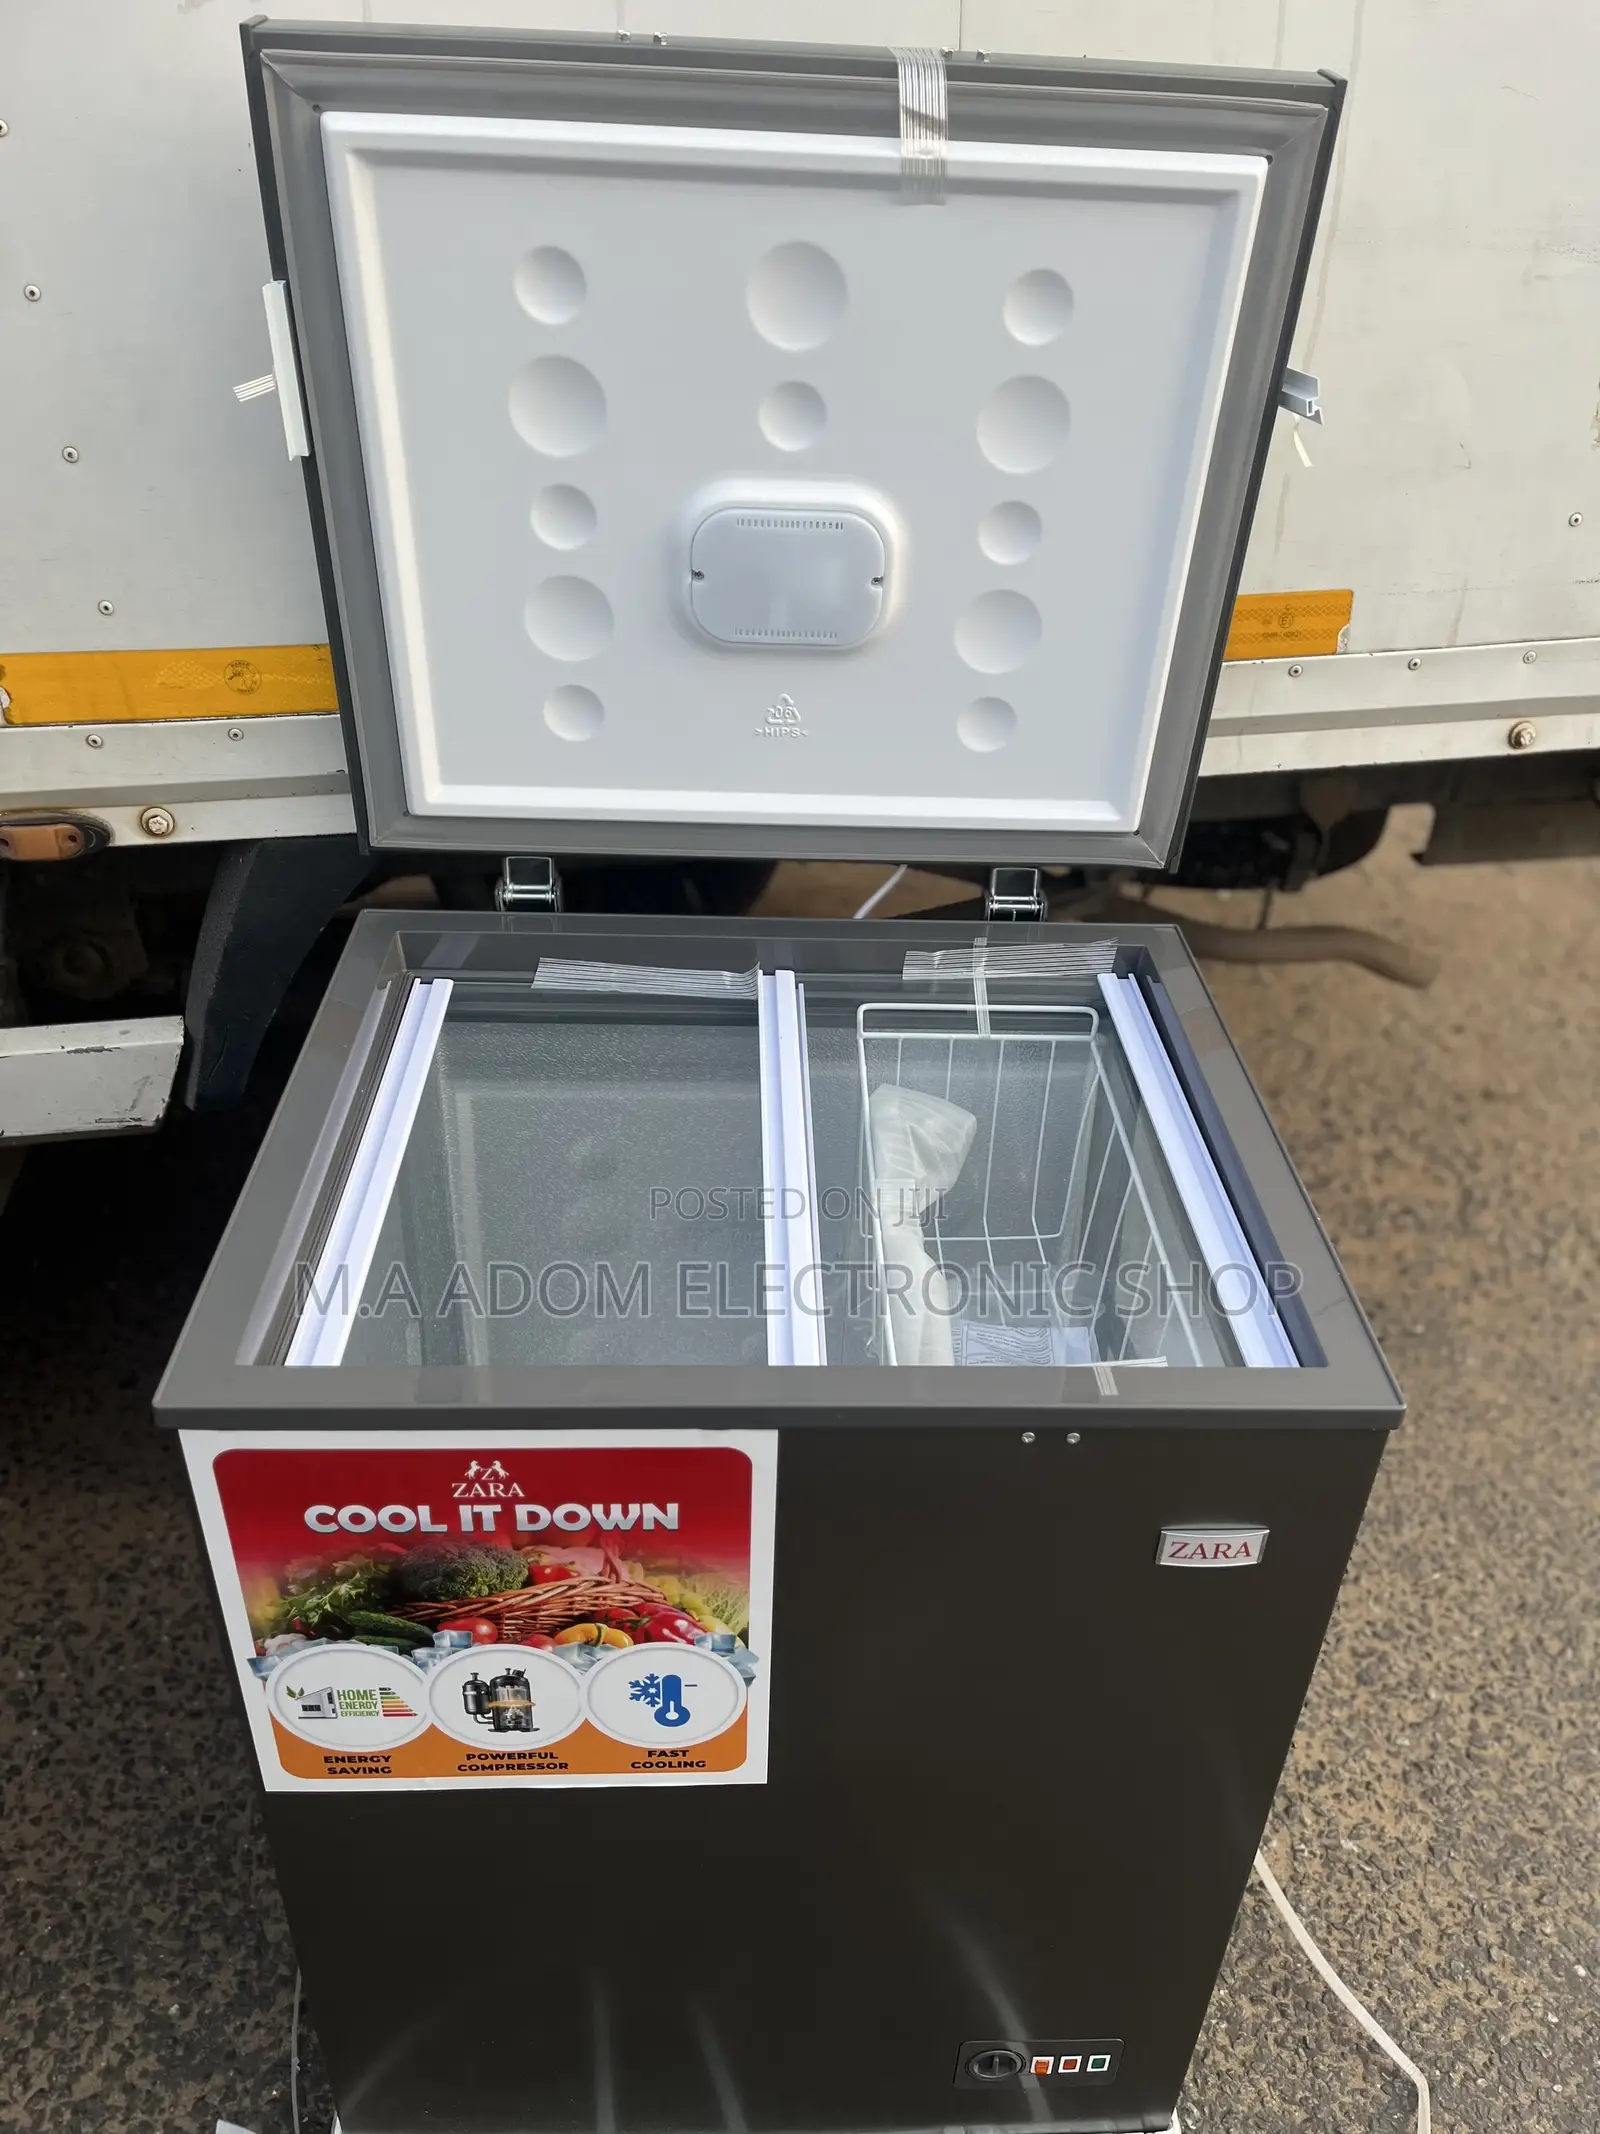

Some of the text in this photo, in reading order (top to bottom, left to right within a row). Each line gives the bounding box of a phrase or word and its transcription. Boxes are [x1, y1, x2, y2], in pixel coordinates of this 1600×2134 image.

[451, 1482, 525, 1498] ZARA
[303, 1502, 679, 1533] COOL IT DOWN
[1168, 1541, 1252, 1560] ZARA
[337, 1689, 378, 1701] HOME
[339, 1701, 378, 1710] ENERGY
[323, 1754, 392, 1765] ENERGY
[465, 1751, 559, 1762] POWERFUL
[647, 1749, 690, 1759] FAST
[327, 1765, 392, 1775] SAVING
[457, 1761, 569, 1772] COMPRESSOR
[630, 1759, 707, 1770] COOLING
